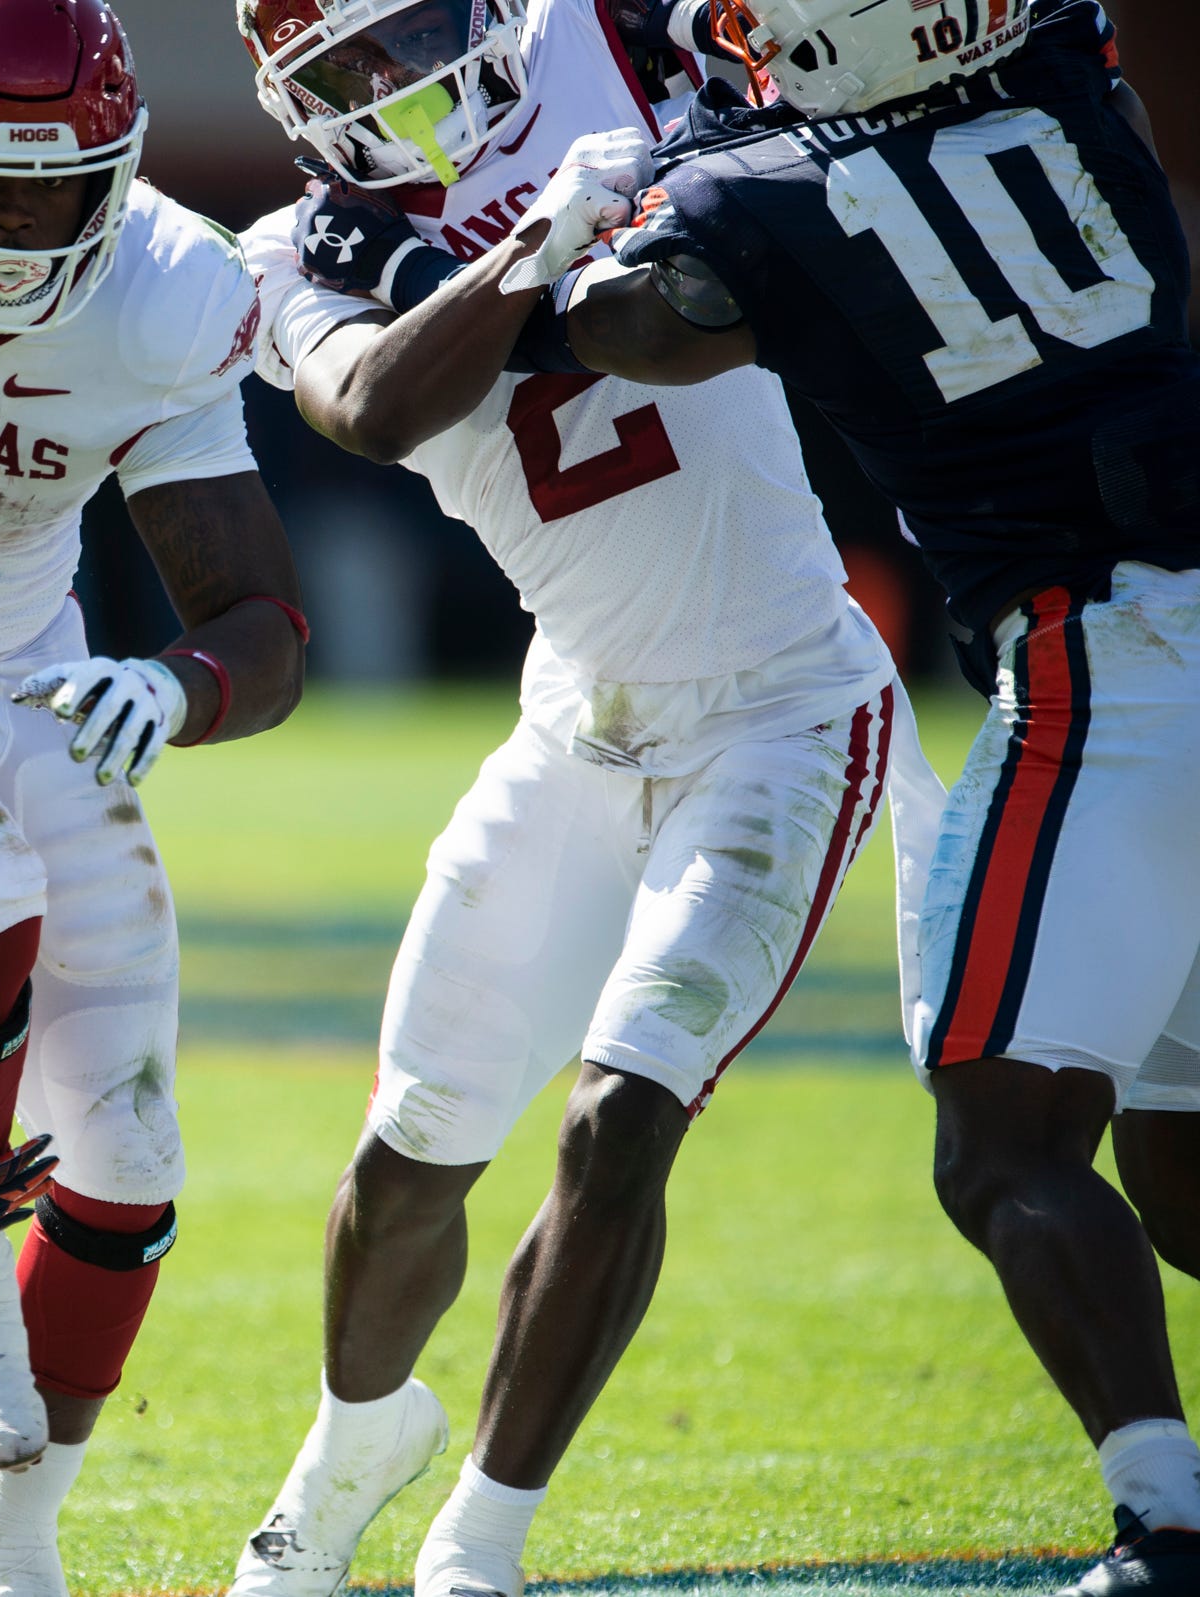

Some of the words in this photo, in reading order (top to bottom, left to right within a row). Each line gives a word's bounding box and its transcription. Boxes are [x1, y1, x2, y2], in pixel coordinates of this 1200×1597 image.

[910, 16, 963, 62] 10
[956, 39, 993, 66] WAR
[9, 128, 59, 142] HOGS
[827, 107, 1156, 404] 10
[506, 372, 681, 524] 2
